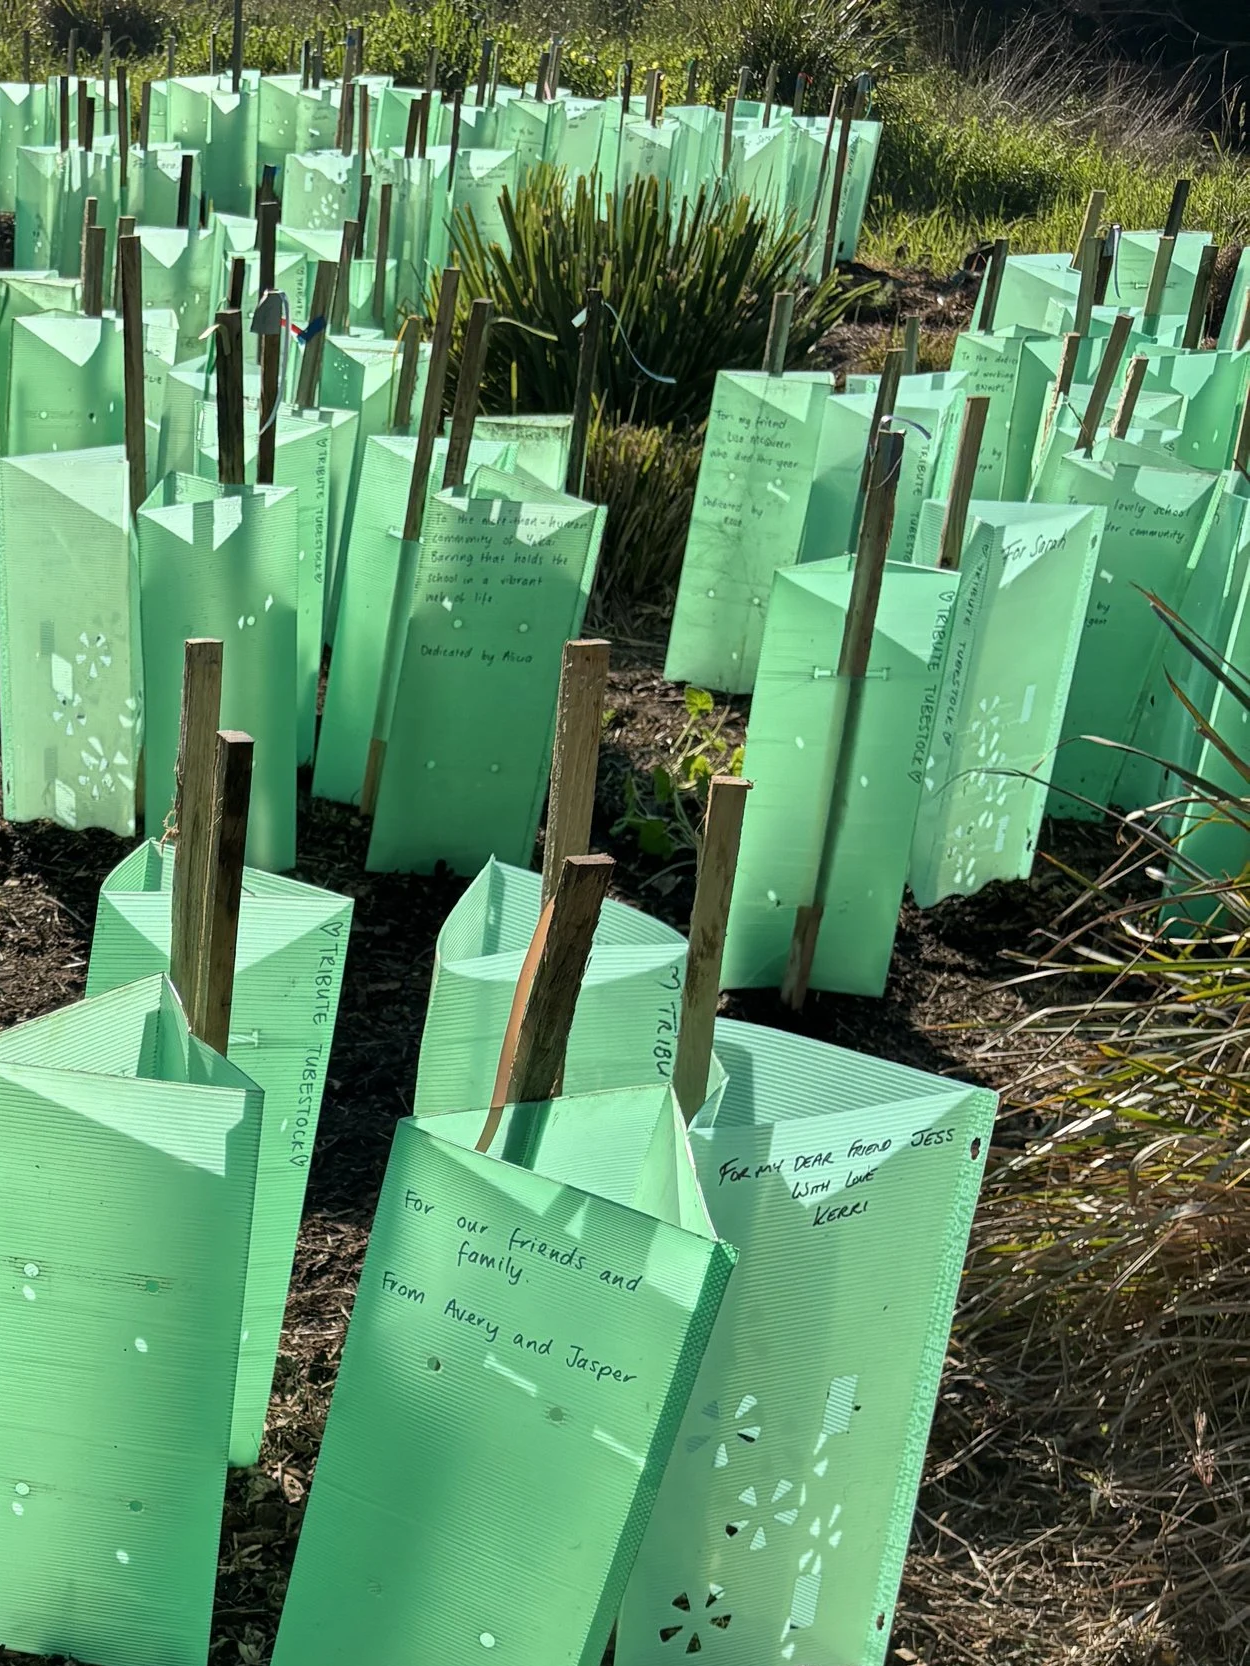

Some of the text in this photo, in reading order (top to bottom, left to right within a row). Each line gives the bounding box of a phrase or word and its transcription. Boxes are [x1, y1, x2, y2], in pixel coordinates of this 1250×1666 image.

[976, 352, 988, 360] the
[913, 444, 930, 496] TRIBUTE
[314, 450, 328, 572] TRIBUTE TUBESTOCK
[458, 512, 474, 526] the
[1114, 498, 1190, 518] lovely school
[503, 535, 514, 546] of
[1002, 529, 1068, 561] For Sarah
[480, 552, 505, 564] that
[514, 552, 543, 566] holds
[552, 554, 568, 566] the
[428, 572, 458, 584] school
[463, 575, 474, 584] in
[501, 575, 543, 586] vibrant
[454, 594, 466, 604] of
[1097, 601, 1110, 615] by
[420, 646, 473, 658] Dedicated
[481, 650, 494, 666] by
[946, 563, 986, 726] TRIBUTE TUBESTOCK
[914, 604, 950, 768] TRIBUTE TUBESTOCK
[291, 943, 345, 1153] TRIBUTE TUBESTOCK
[653, 1001, 679, 1078] TRIBU
[793, 1154, 836, 1173] DEAR
[910, 1127, 956, 1148] JESS
[812, 1201, 870, 1227] KERRI
[403, 1189, 436, 1216] For
[456, 1214, 489, 1236] our
[599, 1268, 644, 1293] and
[382, 1270, 638, 1386] From Avery and Jasper
